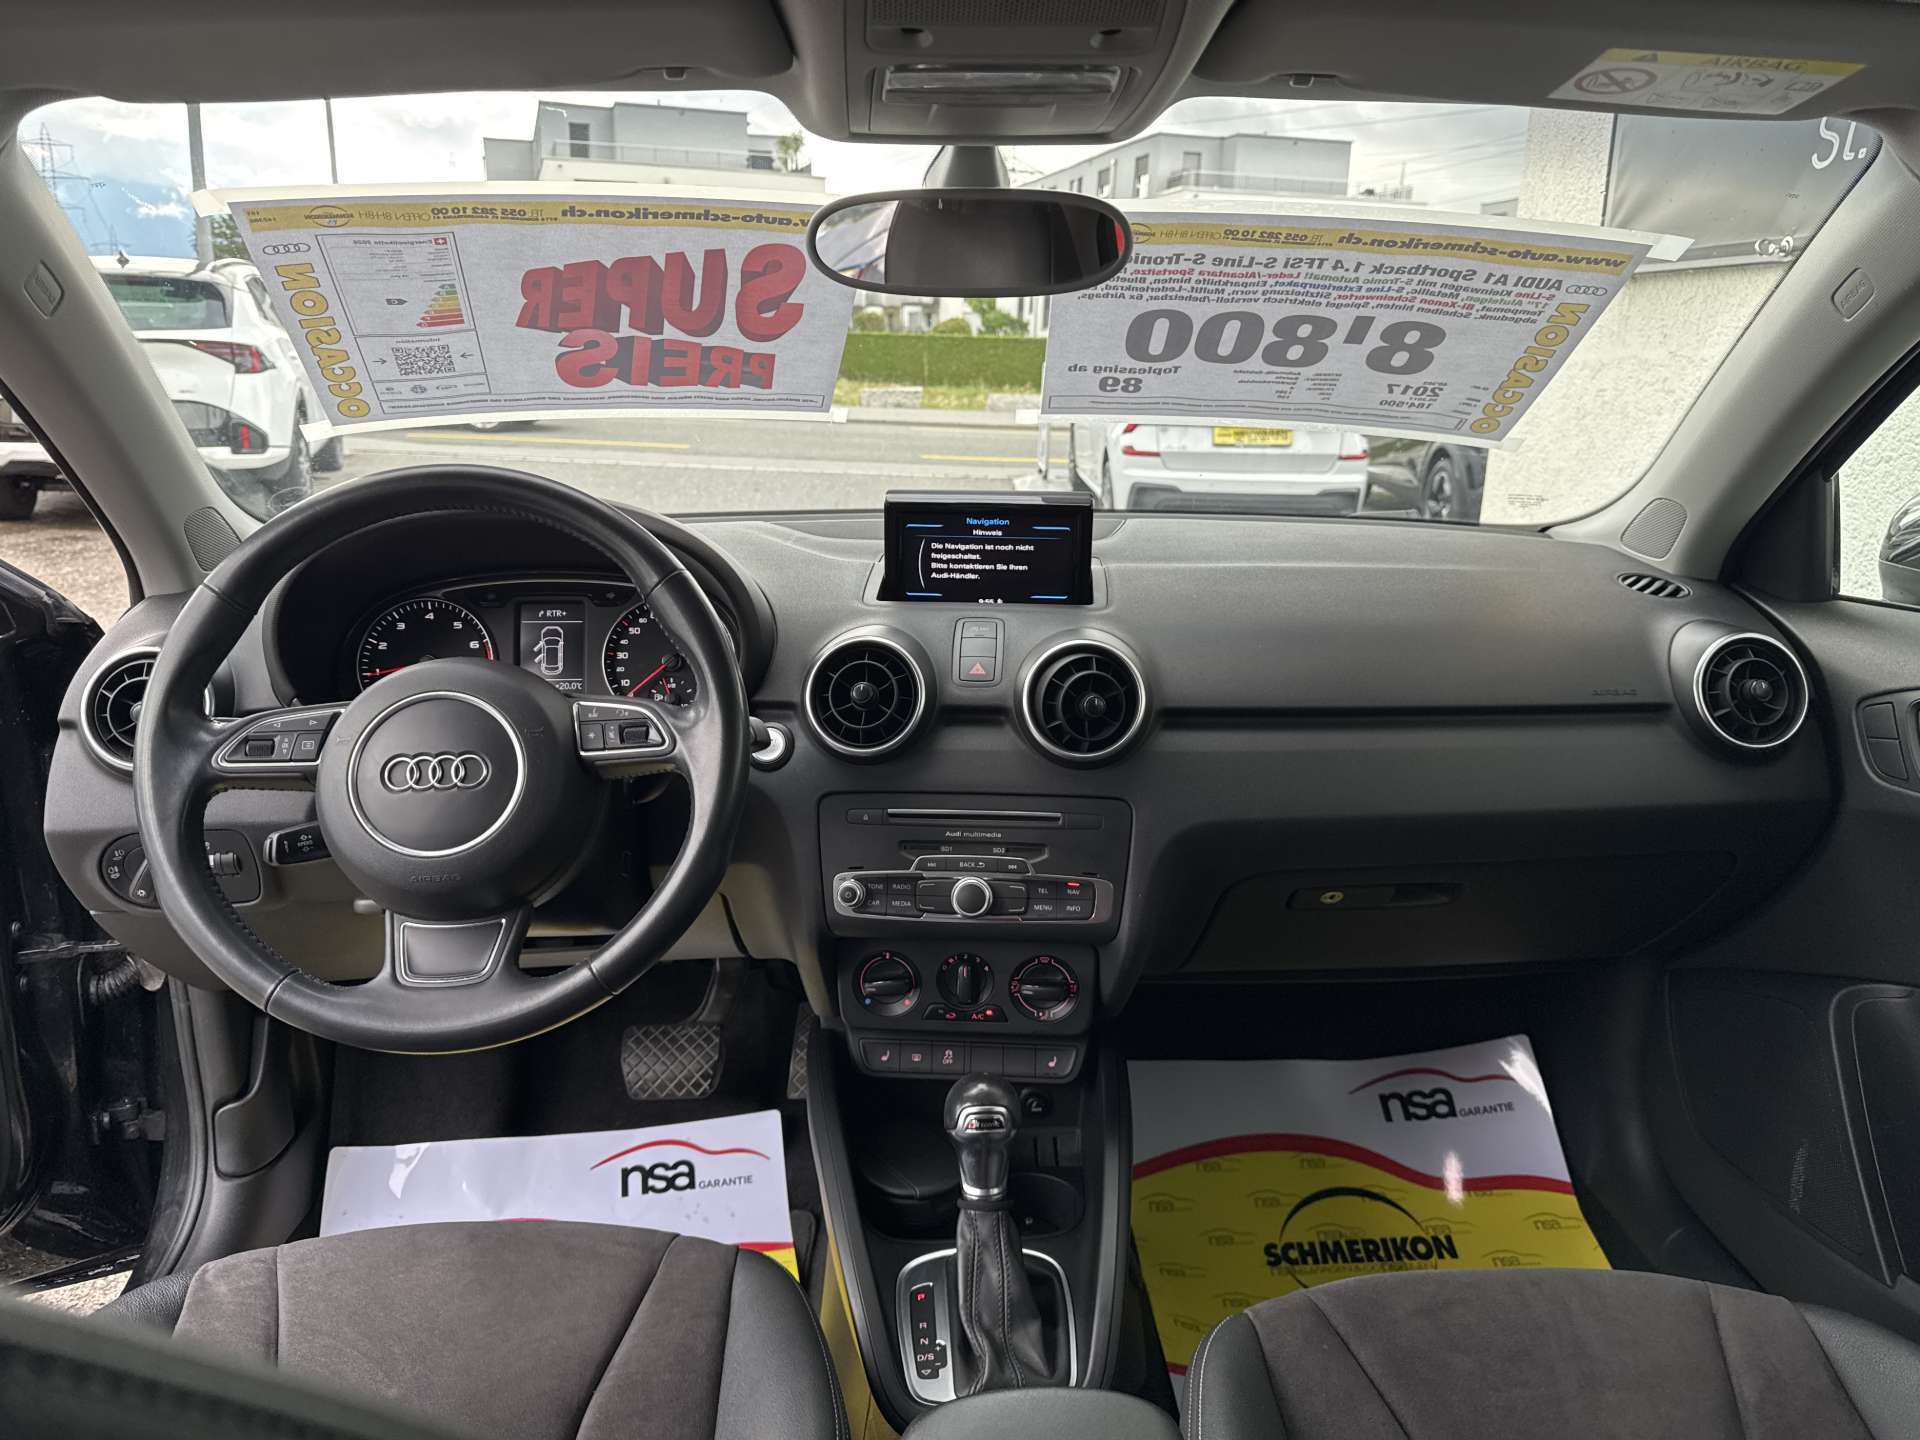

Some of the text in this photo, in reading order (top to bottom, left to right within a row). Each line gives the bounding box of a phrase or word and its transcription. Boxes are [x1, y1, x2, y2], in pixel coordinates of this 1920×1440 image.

[1704, 56, 1806, 71] AIRBAG
[966, 517, 1010, 527] Navigation
[944, 543, 983, 551] Navigation
[931, 552, 982, 560] freigeschaltet.
[949, 562, 995, 570] kontaktieren
[931, 572, 980, 580] Audi-Händler.
[424, 612, 434, 620] 4
[396, 622, 406, 630] 3
[453, 621, 462, 629] 5
[628, 627, 641, 635] 50
[378, 642, 388, 650] 2
[469, 641, 479, 649] 6
[616, 651, 629, 660] 30
[620, 679, 631, 687] 10
[945, 830, 1002, 839] Audi multimedia
[959, 861, 975, 869] BACK
[867, 883, 884, 891] TONE
[892, 883, 912, 891] RADIO
[1037, 887, 1049, 895] TEL
[1066, 888, 1081, 896] NAV
[867, 899, 880, 907] CAR
[891, 900, 912, 908] MEDIA
[1033, 904, 1053, 912] MENU
[971, 1012, 984, 1020] A/C
[942, 1057, 953, 1065] OFF
[1379, 1087, 1515, 1122] nsa GARANTIE
[621, 1159, 753, 1197] nsa GARANTIE
[1264, 1234, 1459, 1267] SCHMERIKON
[917, 1293, 925, 1301] P
[920, 1337, 929, 1345] N
[917, 1353, 935, 1361] D/S
